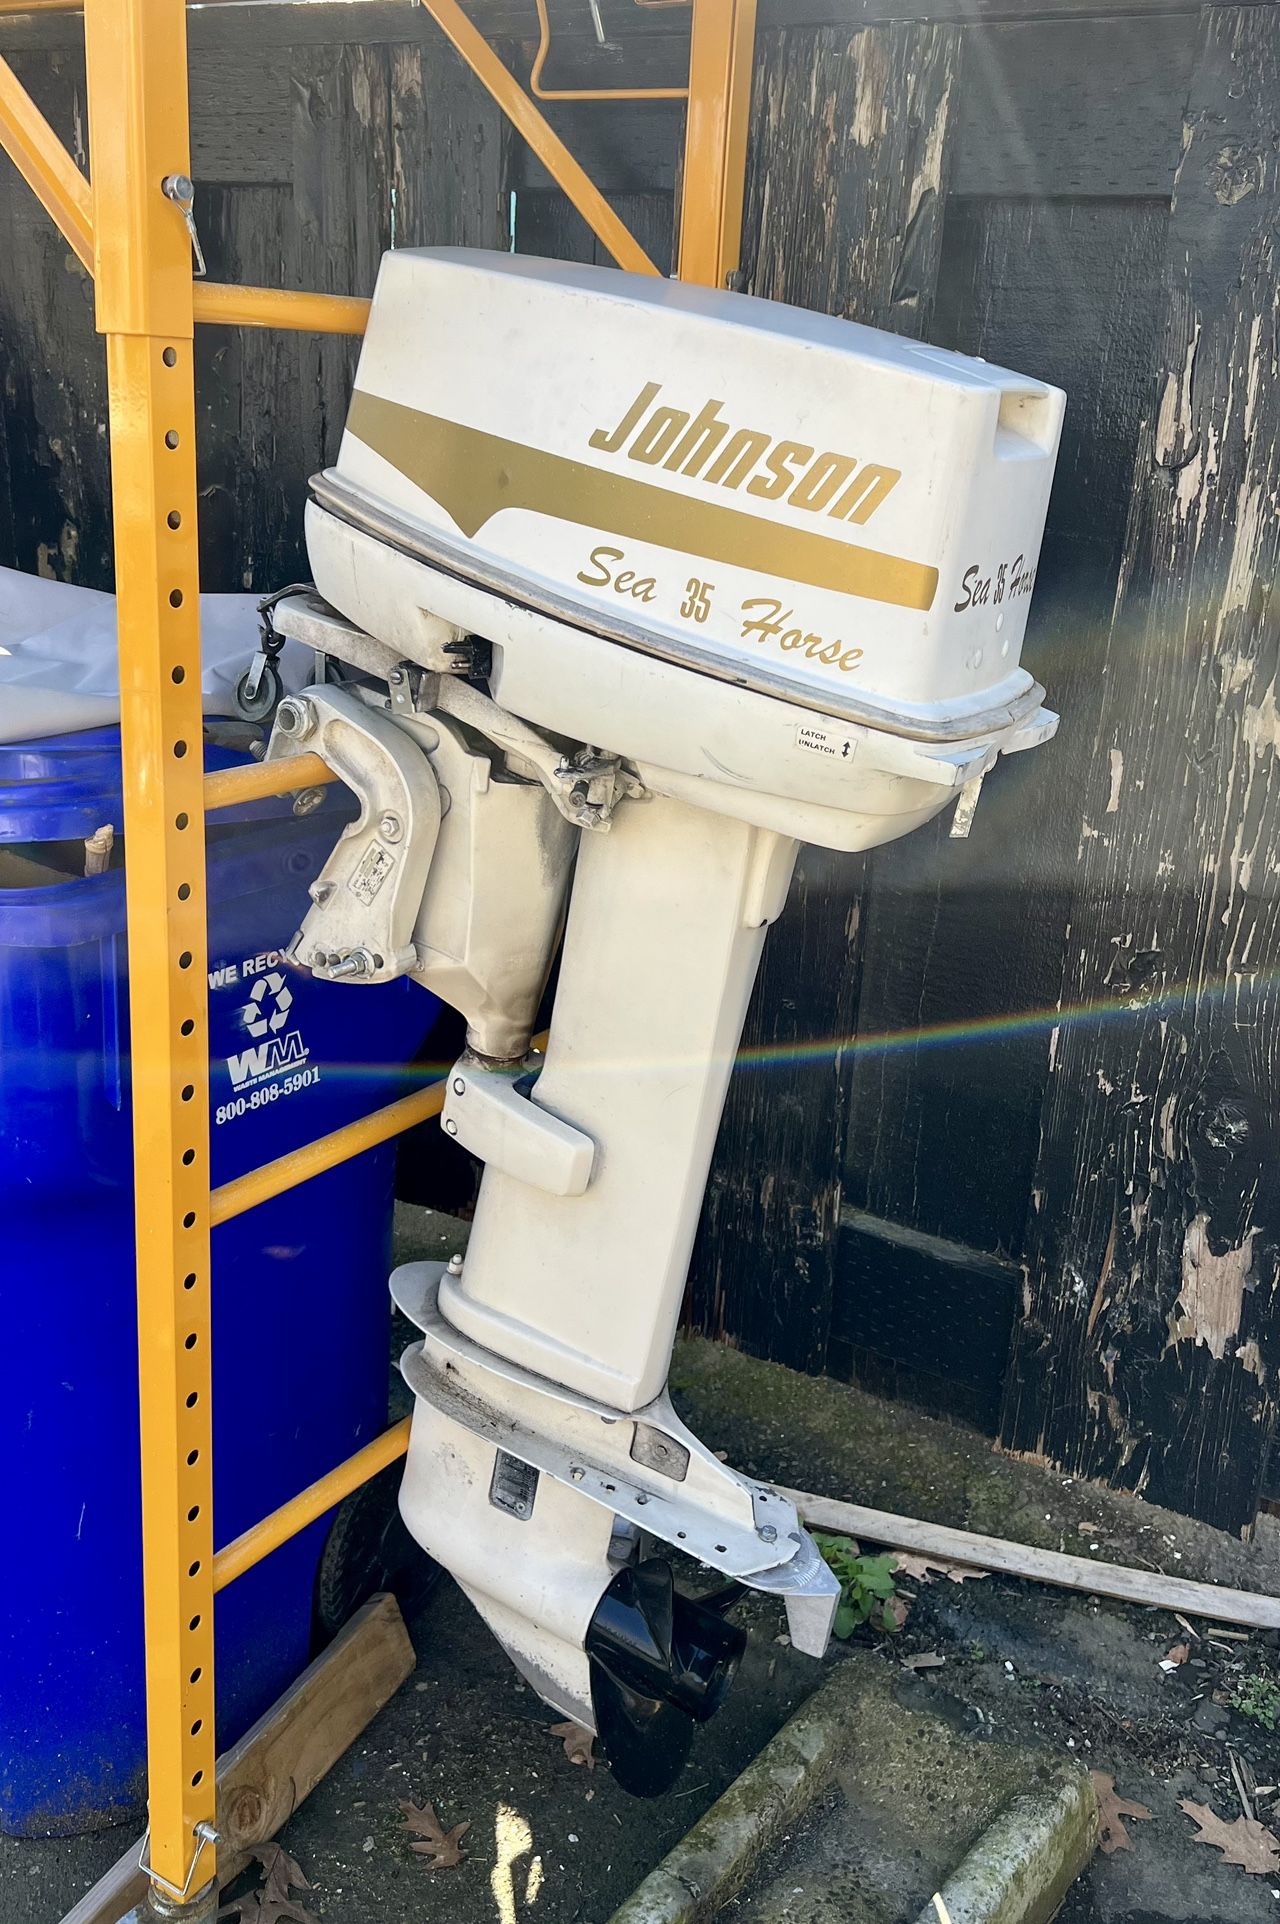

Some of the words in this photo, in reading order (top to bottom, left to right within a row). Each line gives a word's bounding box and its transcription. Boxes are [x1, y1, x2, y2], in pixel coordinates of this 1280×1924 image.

[588, 381, 902, 525] Johnson
[577, 546, 657, 603] Sea
[680, 577, 716, 623] 35
[740, 598, 865, 671] Horse
[954, 564, 992, 613] Sea
[798, 739, 836, 755] UNLATCH
[800, 728, 827, 742] LATCH
[208, 965, 237, 990] WE
[242, 948, 289, 978] RECY
[226, 1030, 305, 1086] WM
[215, 1066, 321, 1125] 800-808-5901
[233, 1076, 258, 1093] WASTE
